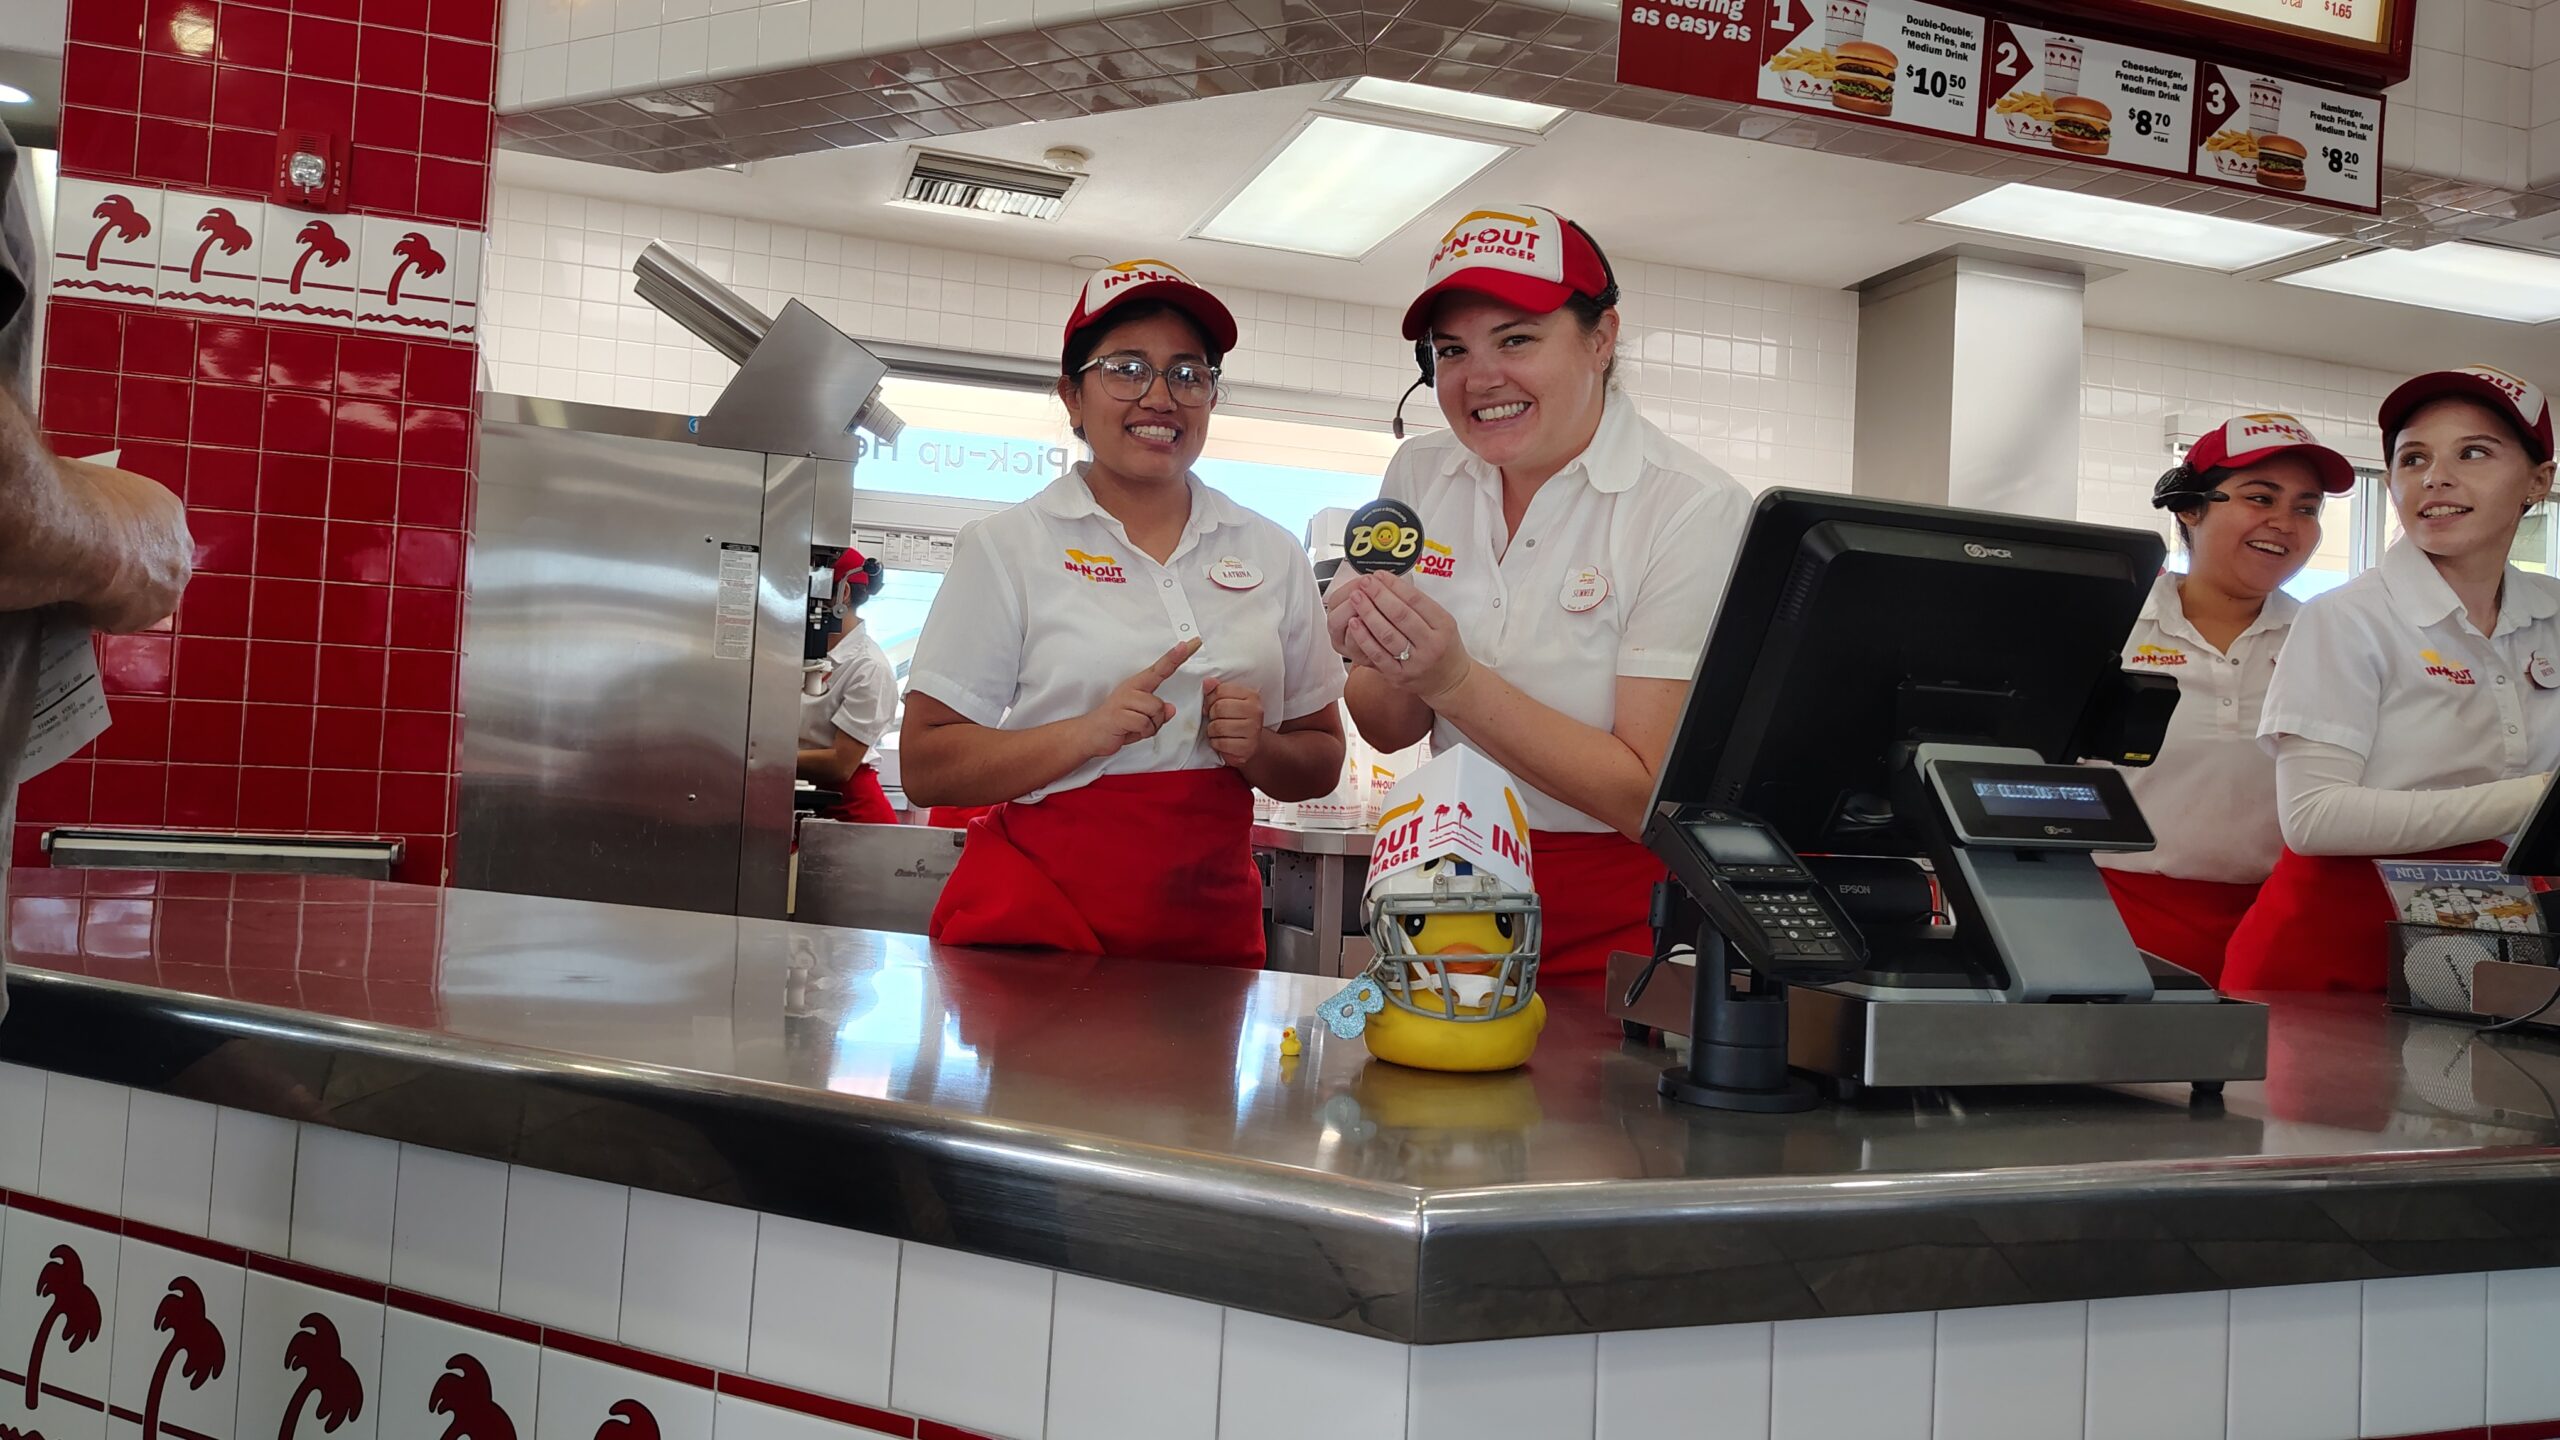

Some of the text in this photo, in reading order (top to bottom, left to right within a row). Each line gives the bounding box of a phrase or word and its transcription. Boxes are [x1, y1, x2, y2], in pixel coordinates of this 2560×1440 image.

[1770, 0, 1795, 32] 1
[2324, 1, 2352, 19] $1.65
[1631, 6, 1752, 42] as easy as
[1901, 26, 1976, 51] French Fries, and
[1907, 40, 1969, 62] Medium Drink
[1995, 41, 2018, 77] 2
[2115, 70, 2188, 92] French Fries, and
[2121, 60, 2184, 80] Cheeseburger,
[2121, 83, 2181, 102] Medium Drink
[2206, 82, 2226, 115] 3
[2310, 110, 2374, 132] French Fries, and
[2321, 101, 2364, 120] Hamburger,
[2315, 123, 2367, 141] Medium Drink
[1473, 245, 1536, 262] BURGER
[1349, 520, 1419, 558] BOB
[2395, 866, 2510, 884] ACTIVITY FUN
[1840, 884, 1871, 894] EPSON
